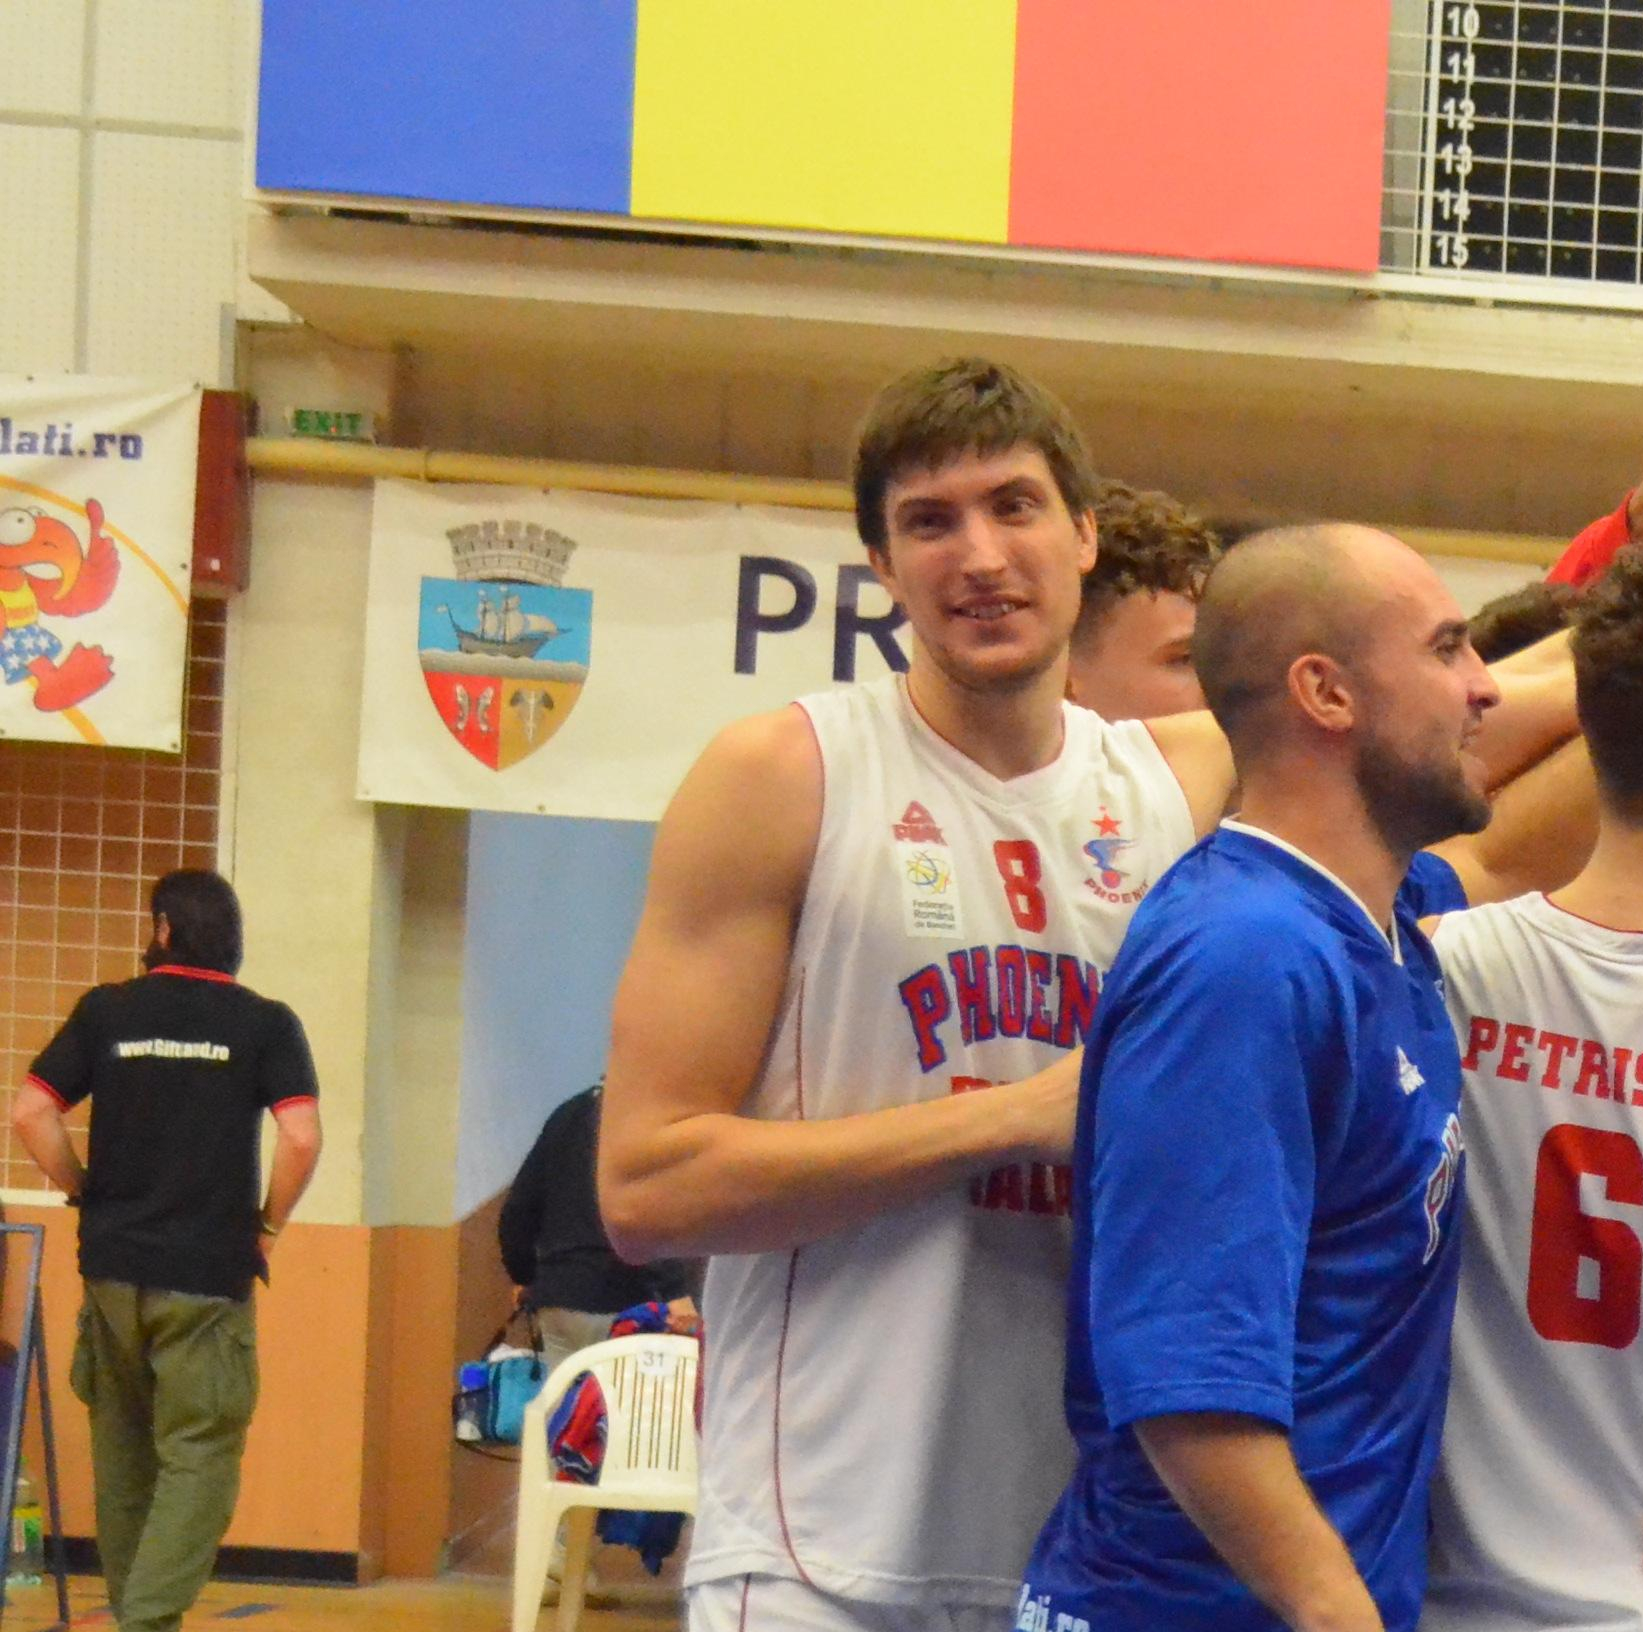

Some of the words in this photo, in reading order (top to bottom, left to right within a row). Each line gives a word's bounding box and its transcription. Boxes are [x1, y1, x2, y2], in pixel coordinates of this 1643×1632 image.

[1448, 6, 1480, 38] 10
[1447, 52, 1475, 84] 11
[1443, 97, 1475, 131] 12
[1441, 142, 1473, 175] 13
[1438, 188, 1471, 221] 14
[1436, 233, 1468, 267] 15
[0, 416, 144, 460] lati.ro
[993, 839, 1048, 934] 8
